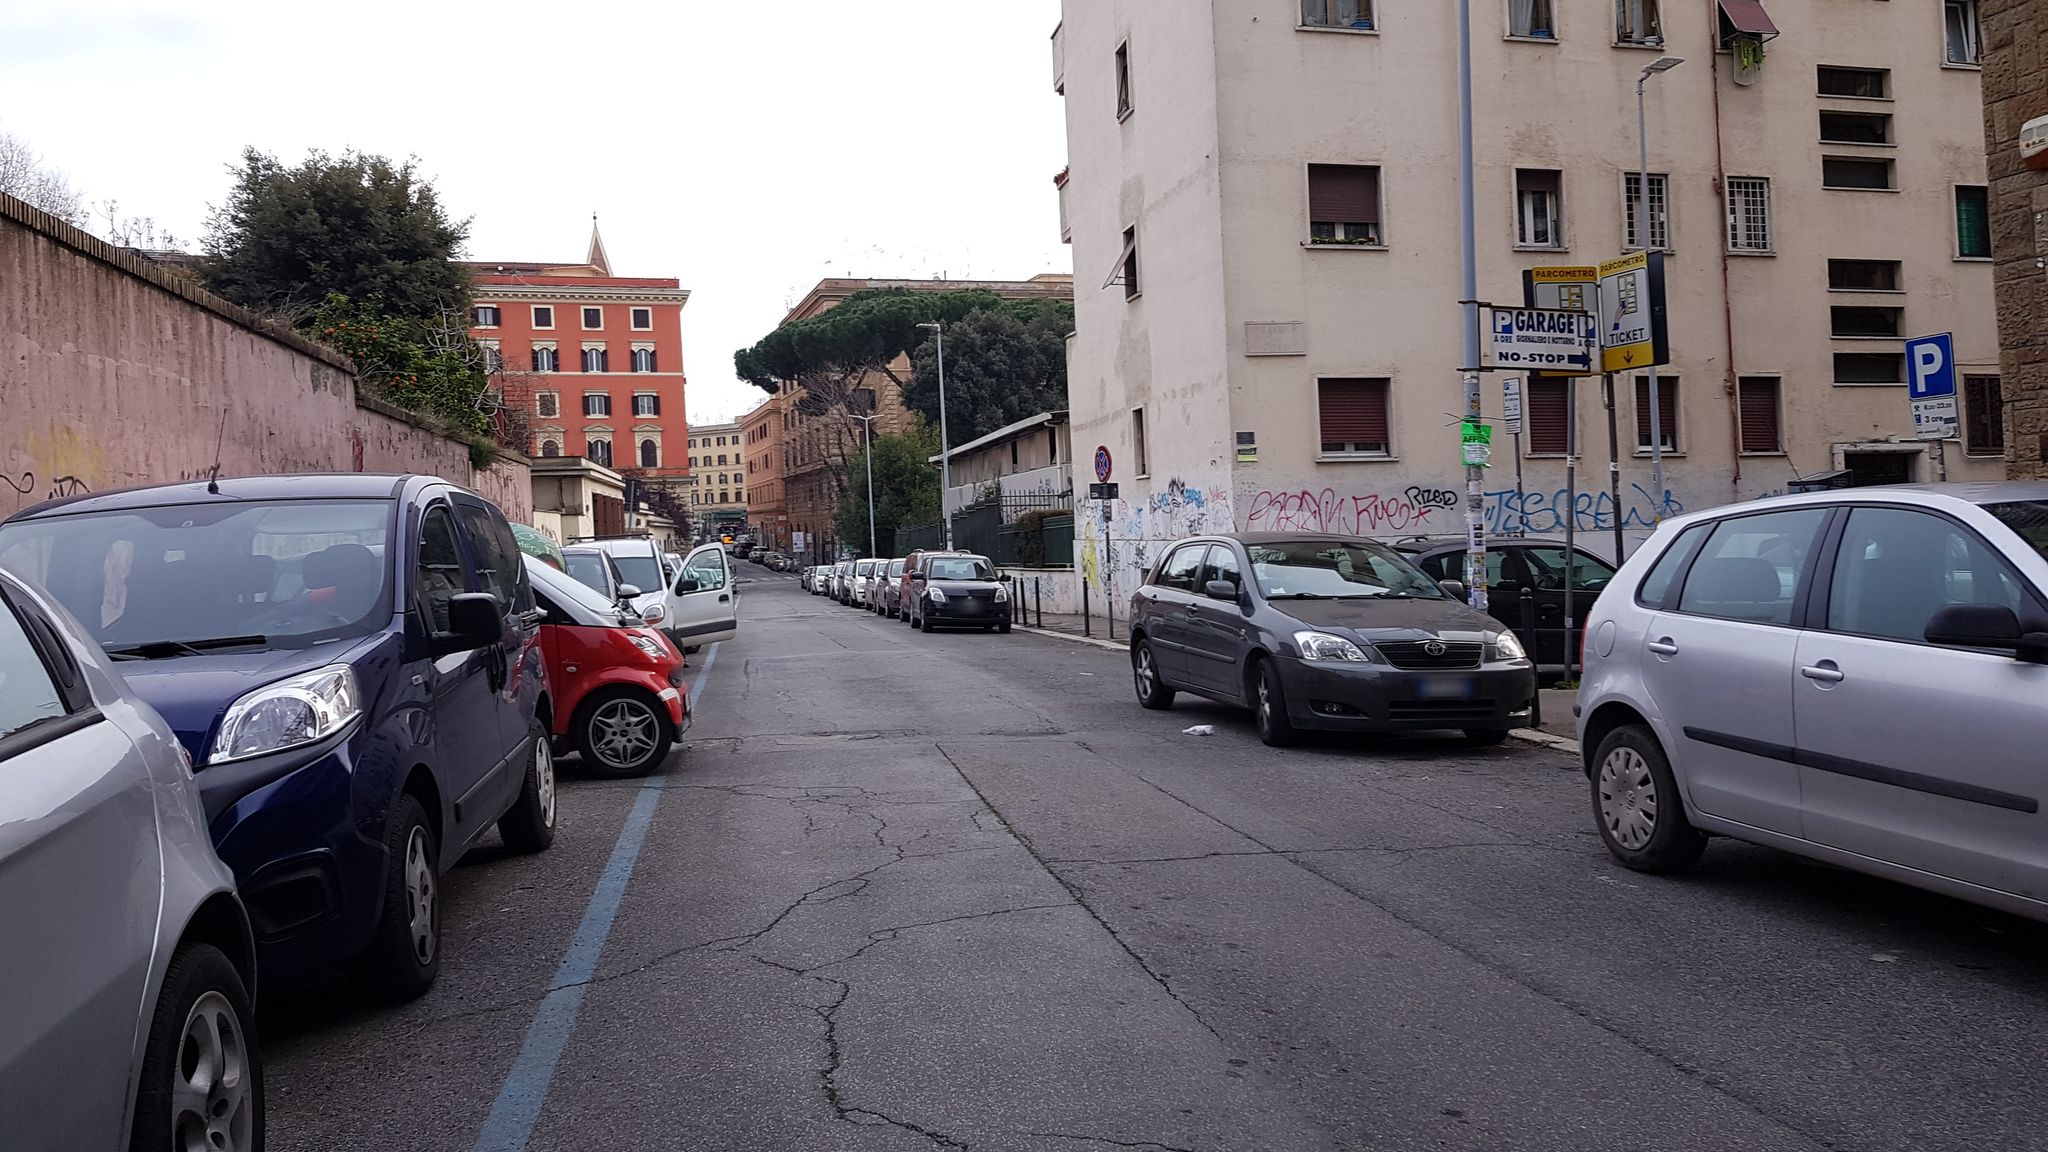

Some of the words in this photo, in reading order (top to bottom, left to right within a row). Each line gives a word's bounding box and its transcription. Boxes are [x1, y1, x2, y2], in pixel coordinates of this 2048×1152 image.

[1600, 255, 1644, 272] PARCOMETRO
[1535, 269, 1595, 278] PARCOMETRO
[1515, 311, 1575, 334] GARAGE
[1608, 328, 1645, 345] TICKET
[1498, 351, 1566, 364] NO-STOP
[1913, 342, 1943, 393] P
[1924, 415, 1930, 423] 3
